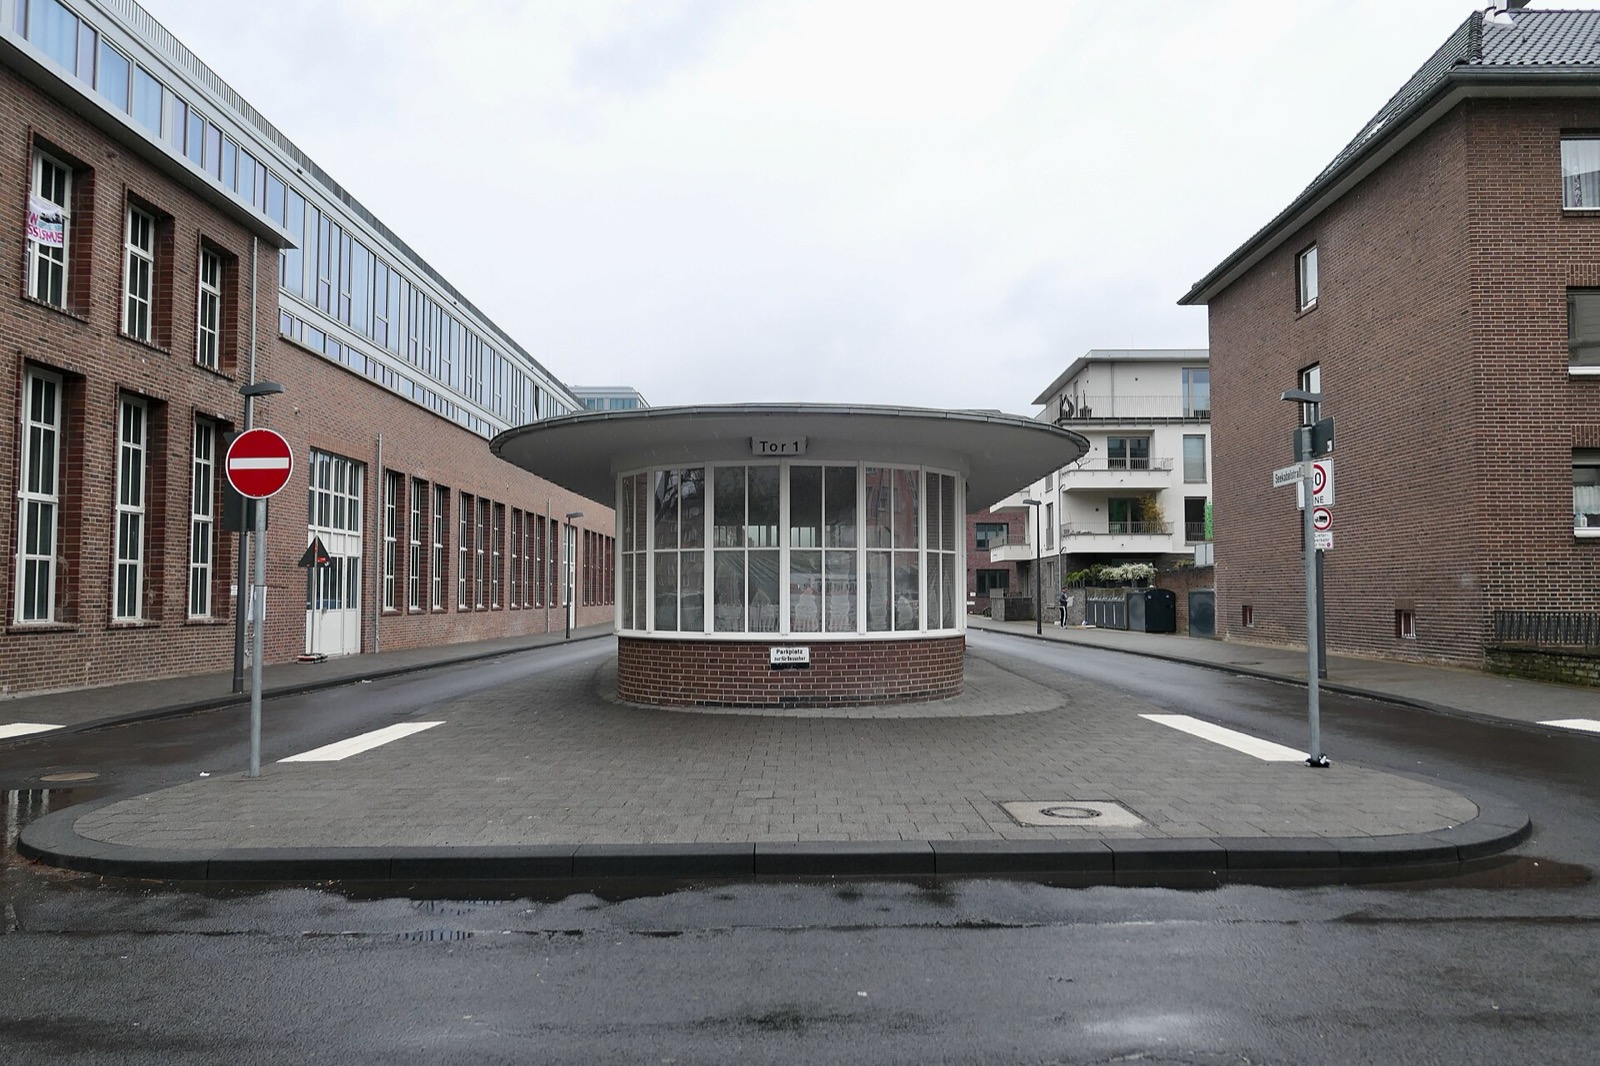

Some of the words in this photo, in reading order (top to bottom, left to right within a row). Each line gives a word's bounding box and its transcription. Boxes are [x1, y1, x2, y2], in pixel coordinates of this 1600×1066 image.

[759, 441, 786, 452] Tor
[793, 441, 798, 452] 1
[1275, 467, 1301, 484] Seekabelstraß
[1315, 472, 1321, 486] 0
[1314, 495, 1324, 504] NE
